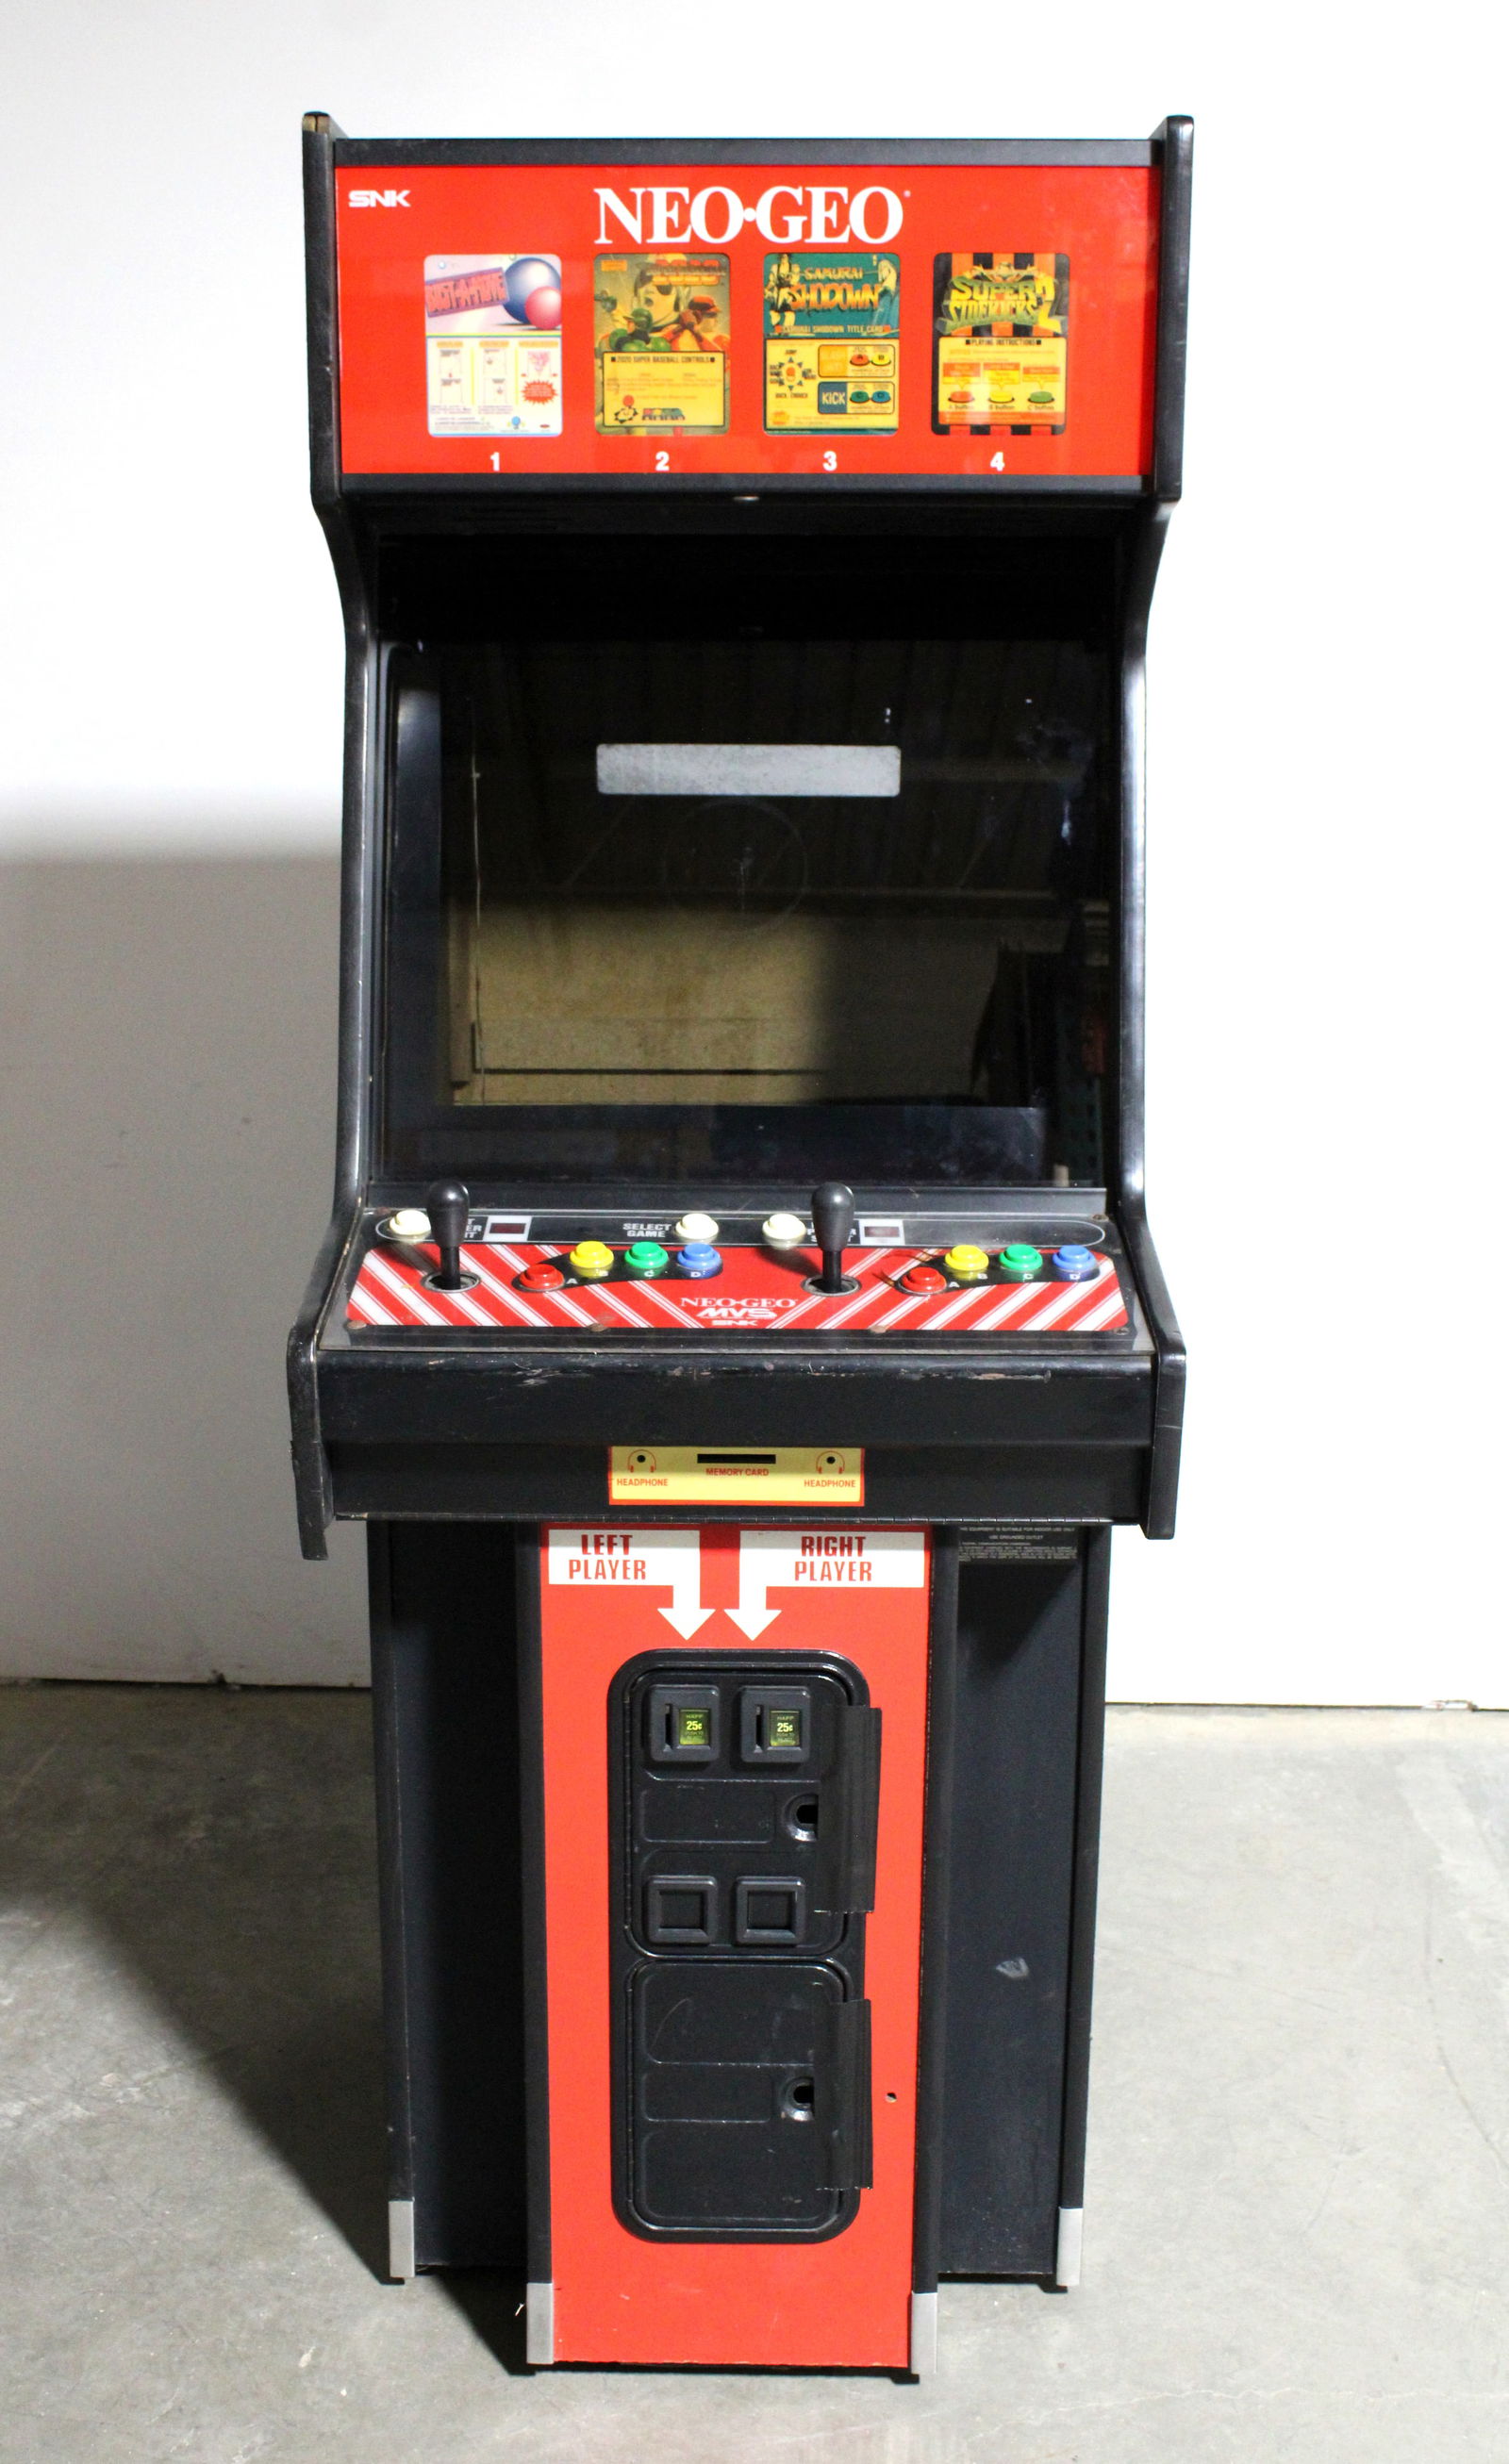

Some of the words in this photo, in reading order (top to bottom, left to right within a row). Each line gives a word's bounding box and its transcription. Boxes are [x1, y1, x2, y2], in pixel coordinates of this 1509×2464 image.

[349, 190, 411, 207] SNK
[804, 267, 864, 281] SAMURAI
[790, 282, 883, 310] SHODOWN
[949, 275, 1037, 302] SUPER
[946, 300, 1039, 326] SIDEKICKS
[821, 391, 847, 405] KICK
[489, 452, 502, 471] 1
[655, 452, 671, 471] 2
[822, 452, 838, 471] 3
[989, 452, 1005, 471] 4
[622, 1222, 672, 1232] SELECT
[626, 1230, 666, 1238] GAME
[643, 1269, 655, 1278] C
[695, 1307, 778, 1320] MVS
[705, 1467, 743, 1477] MEMORY
[745, 1468, 770, 1477] CARD
[616, 1478, 669, 1487] HEADPHONE
[804, 1479, 856, 1488] HEADPHONE
[581, 1534, 633, 1556] LEFT
[801, 1535, 867, 1558] RIGHT
[568, 1559, 646, 1580] PLAYER
[794, 1561, 872, 1582] PLAYER
